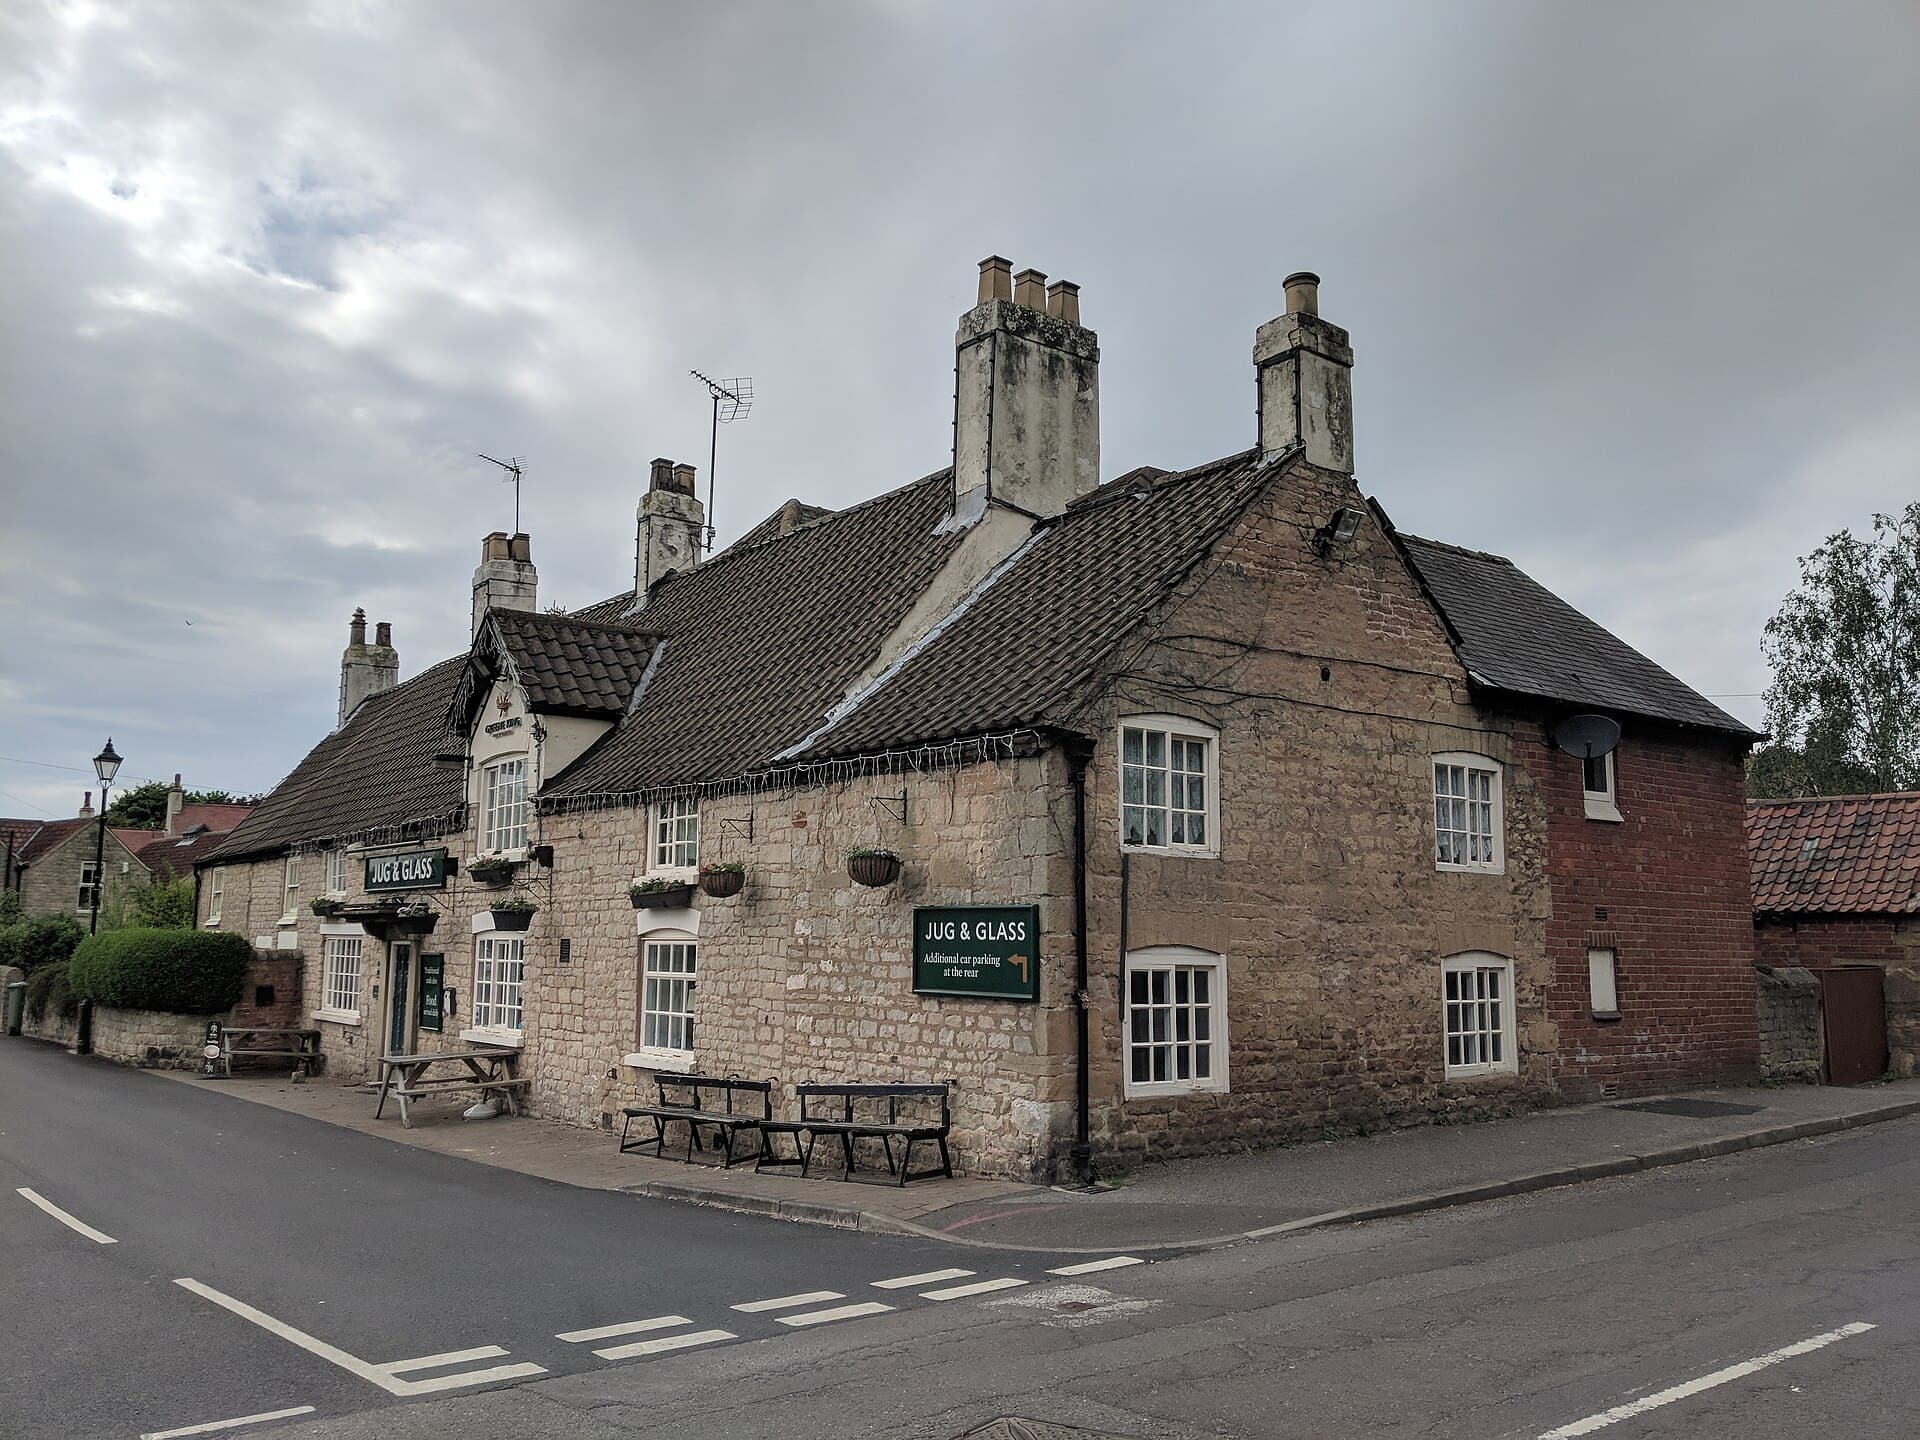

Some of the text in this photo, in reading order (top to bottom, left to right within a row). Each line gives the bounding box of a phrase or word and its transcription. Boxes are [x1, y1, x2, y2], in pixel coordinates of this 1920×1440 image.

[372, 857, 433, 884] JUG & GLASS
[925, 921, 1026, 941] JUG & GLASS
[923, 952, 1001, 968] Additional car parking
[943, 966, 979, 978] at the rear
